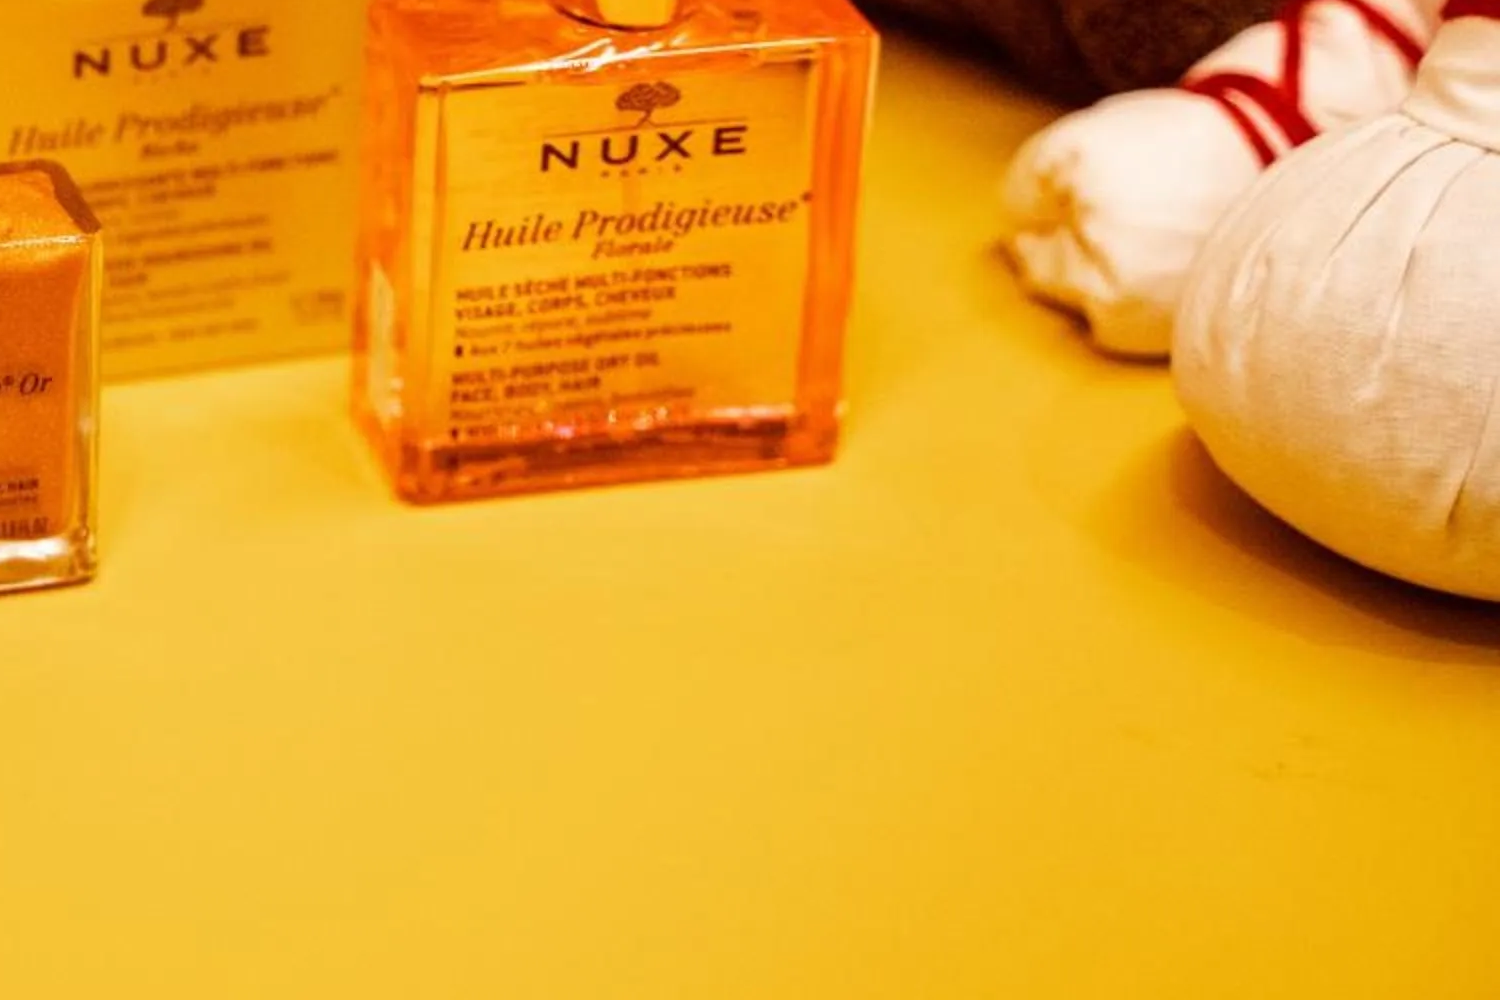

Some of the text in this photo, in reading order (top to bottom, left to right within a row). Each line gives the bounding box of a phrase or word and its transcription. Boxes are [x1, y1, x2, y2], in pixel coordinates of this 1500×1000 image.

[73, 26, 270, 78] NUXE
[8, 119, 104, 156] Huile
[540, 125, 748, 172] NUXE
[462, 213, 564, 252] Huile
[591, 237, 673, 260] Florale
[455, 284, 508, 302] HUILE
[19, 372, 53, 394] Or
